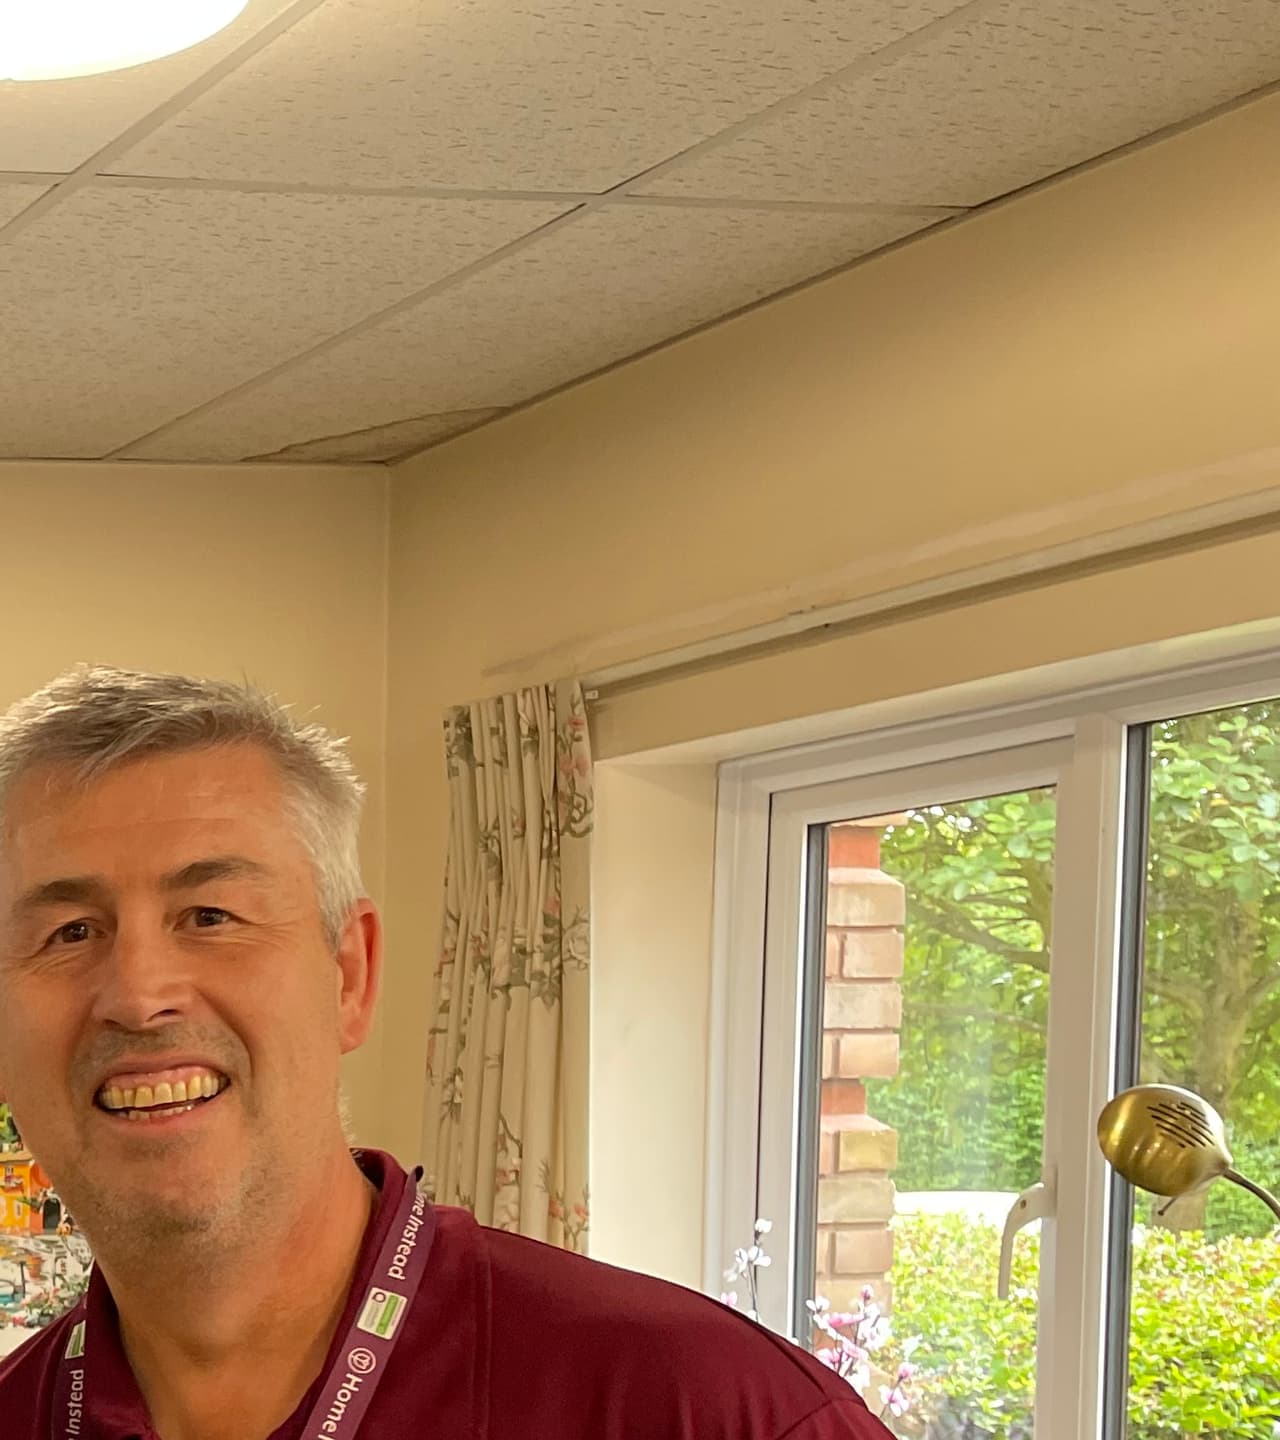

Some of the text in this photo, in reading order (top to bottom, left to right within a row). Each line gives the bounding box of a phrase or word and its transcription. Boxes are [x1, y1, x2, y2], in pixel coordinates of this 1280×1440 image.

[387, 1214, 424, 1280] Instead
[65, 1369, 85, 1435] Instead
[322, 1373, 363, 1433] Home
